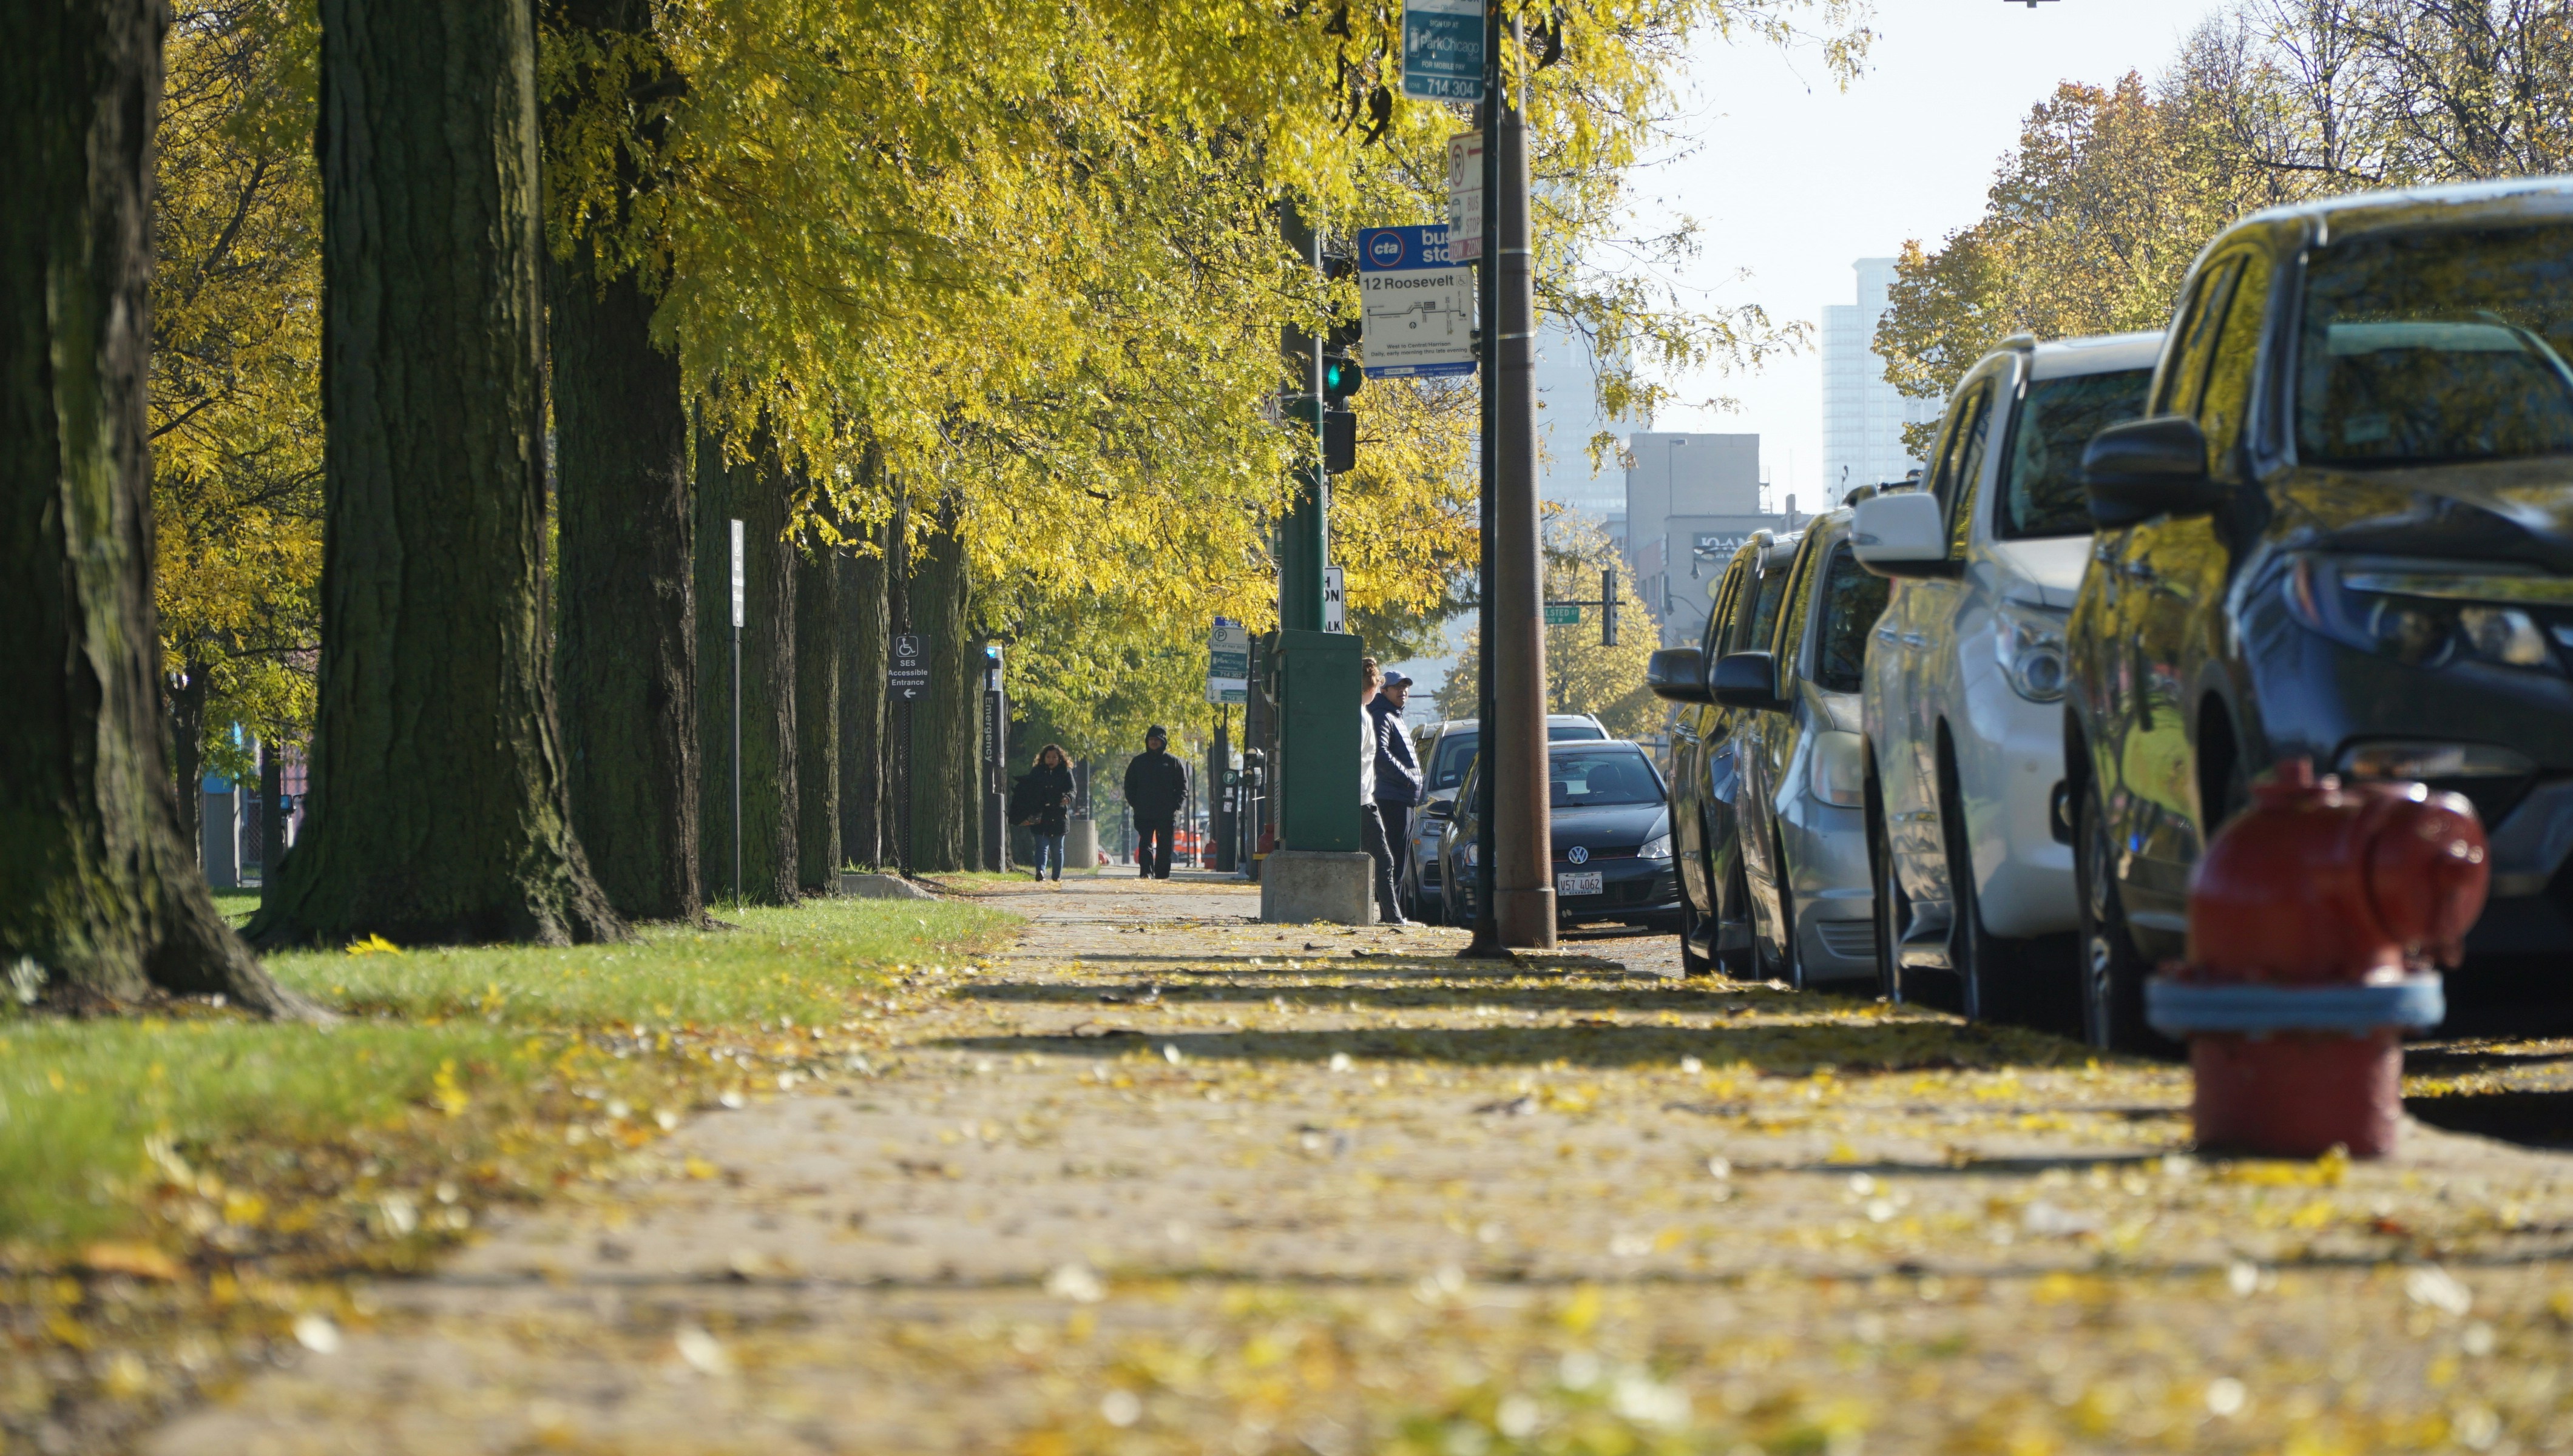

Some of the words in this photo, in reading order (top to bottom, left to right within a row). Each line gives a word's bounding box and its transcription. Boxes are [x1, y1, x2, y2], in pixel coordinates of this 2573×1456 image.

[1420, 35, 1479, 56] ParkChicago
[1427, 78, 1449, 95] 714
[1452, 81, 1474, 97] 304
[1467, 195, 1479, 212] BUS
[1466, 217, 1480, 234] STOP
[1374, 242, 1399, 255] cta
[1422, 246, 1456, 265] sto
[1451, 242, 1463, 258] TOW
[1364, 277, 1381, 291] 12
[1384, 275, 1454, 290] Roosevelt
[984, 696, 993, 763] Emergency
[1560, 879, 1575, 891] V57
[1580, 878, 1600, 891] 4062
